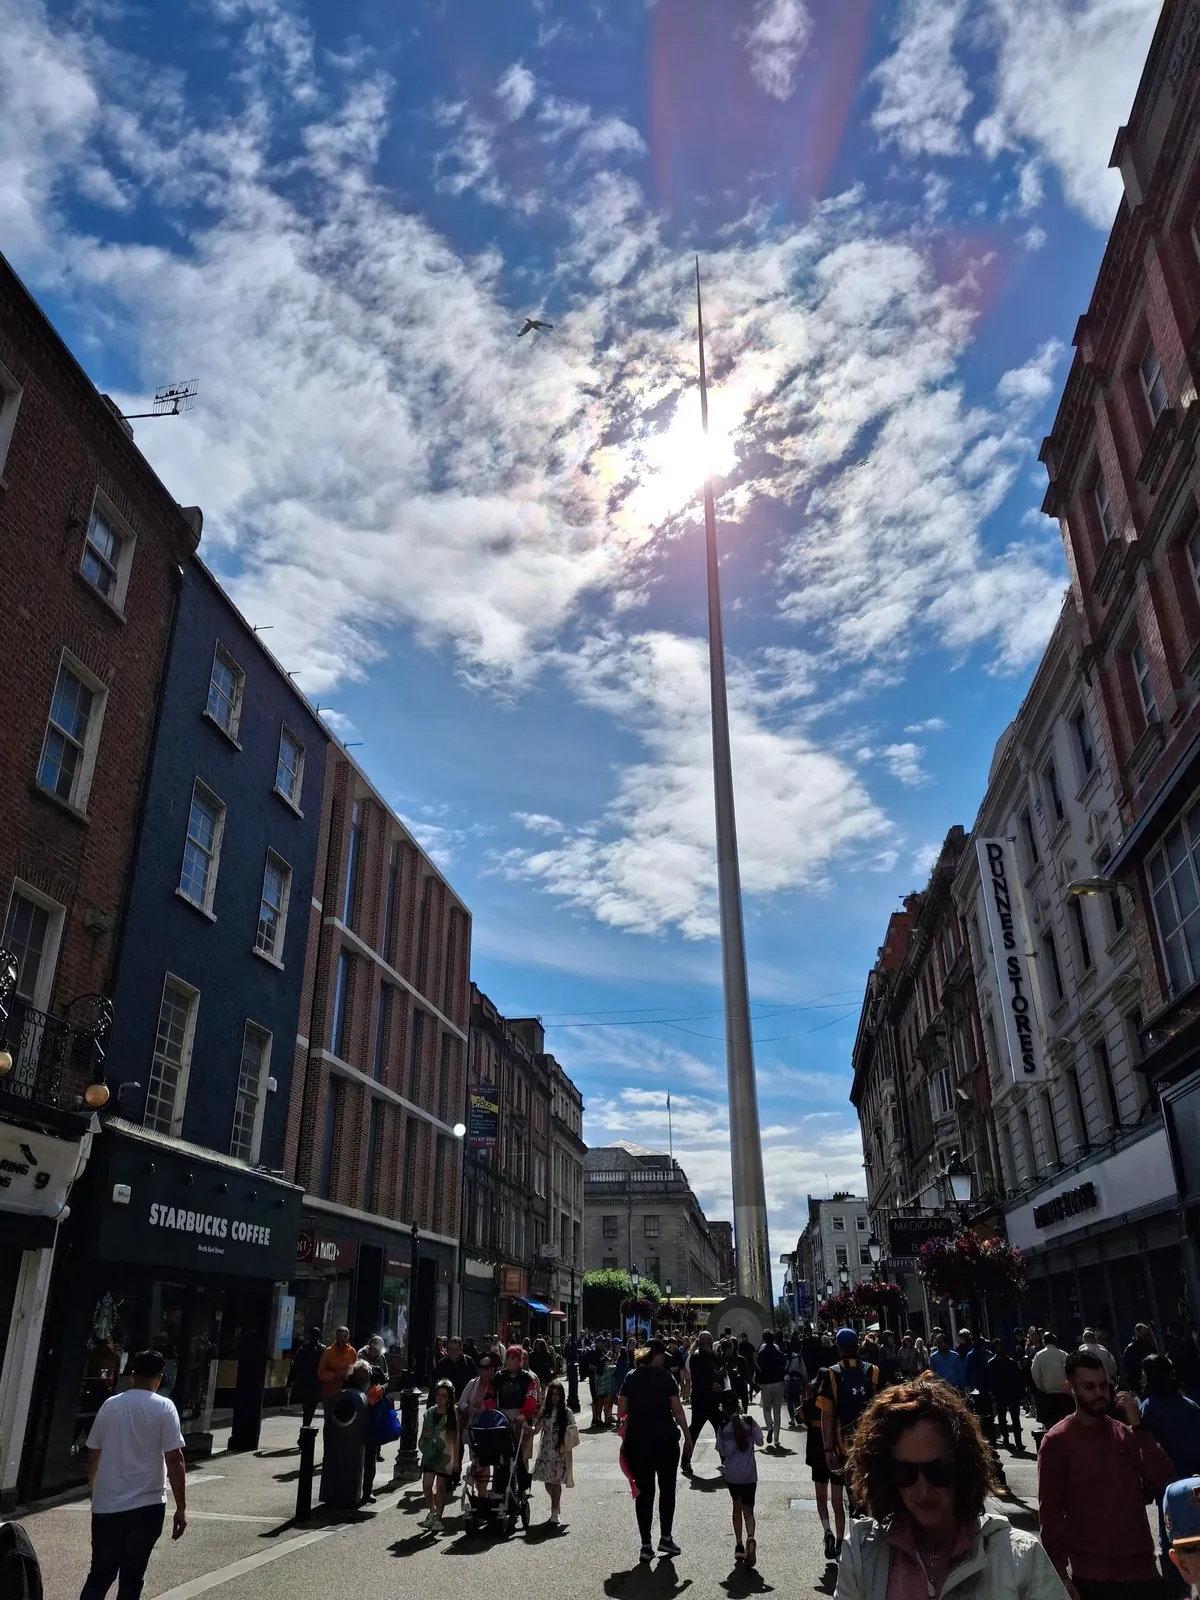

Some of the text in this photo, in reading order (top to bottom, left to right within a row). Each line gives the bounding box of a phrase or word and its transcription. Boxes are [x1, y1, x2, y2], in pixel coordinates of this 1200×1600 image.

[985, 843, 1036, 1074] DUNNES STORES
[476, 1098, 492, 1108] SOLD
[35, 1171, 51, 1189] 9
[149, 1202, 271, 1246] STARBUCKS COFFEE
[894, 1220, 947, 1231] MADIGANS
[888, 1260, 914, 1268] DUFFY'S
